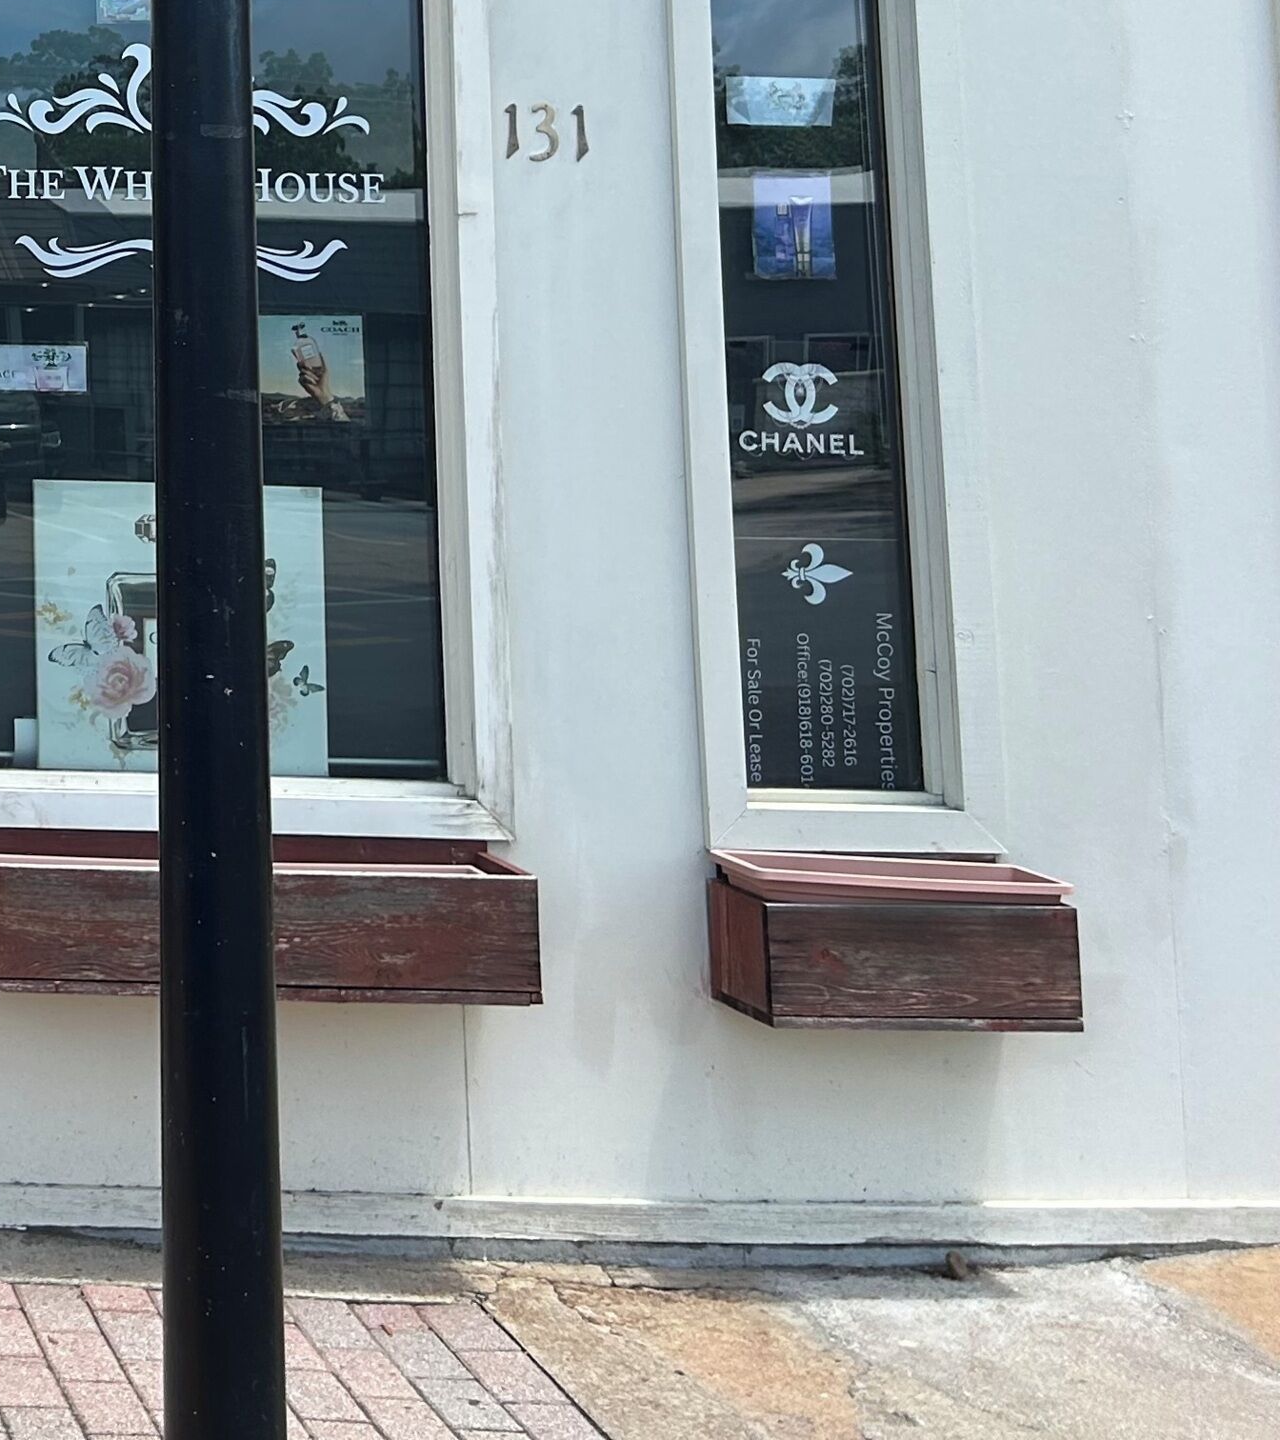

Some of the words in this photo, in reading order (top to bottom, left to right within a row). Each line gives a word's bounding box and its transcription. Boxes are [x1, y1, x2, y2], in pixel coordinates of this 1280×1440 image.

[504, 101, 589, 162] 131
[739, 430, 864, 455] CHANEL
[746, 638, 761, 666] For
[873, 612, 894, 681] McCoy
[747, 669, 762, 705] Sale
[796, 632, 814, 788] Office:(918)618-601
[818, 659, 835, 768] (702)280-5282
[748, 708, 763, 730] Or
[840, 664, 857, 767] (702)717-2616
[749, 734, 763, 783] Lease
